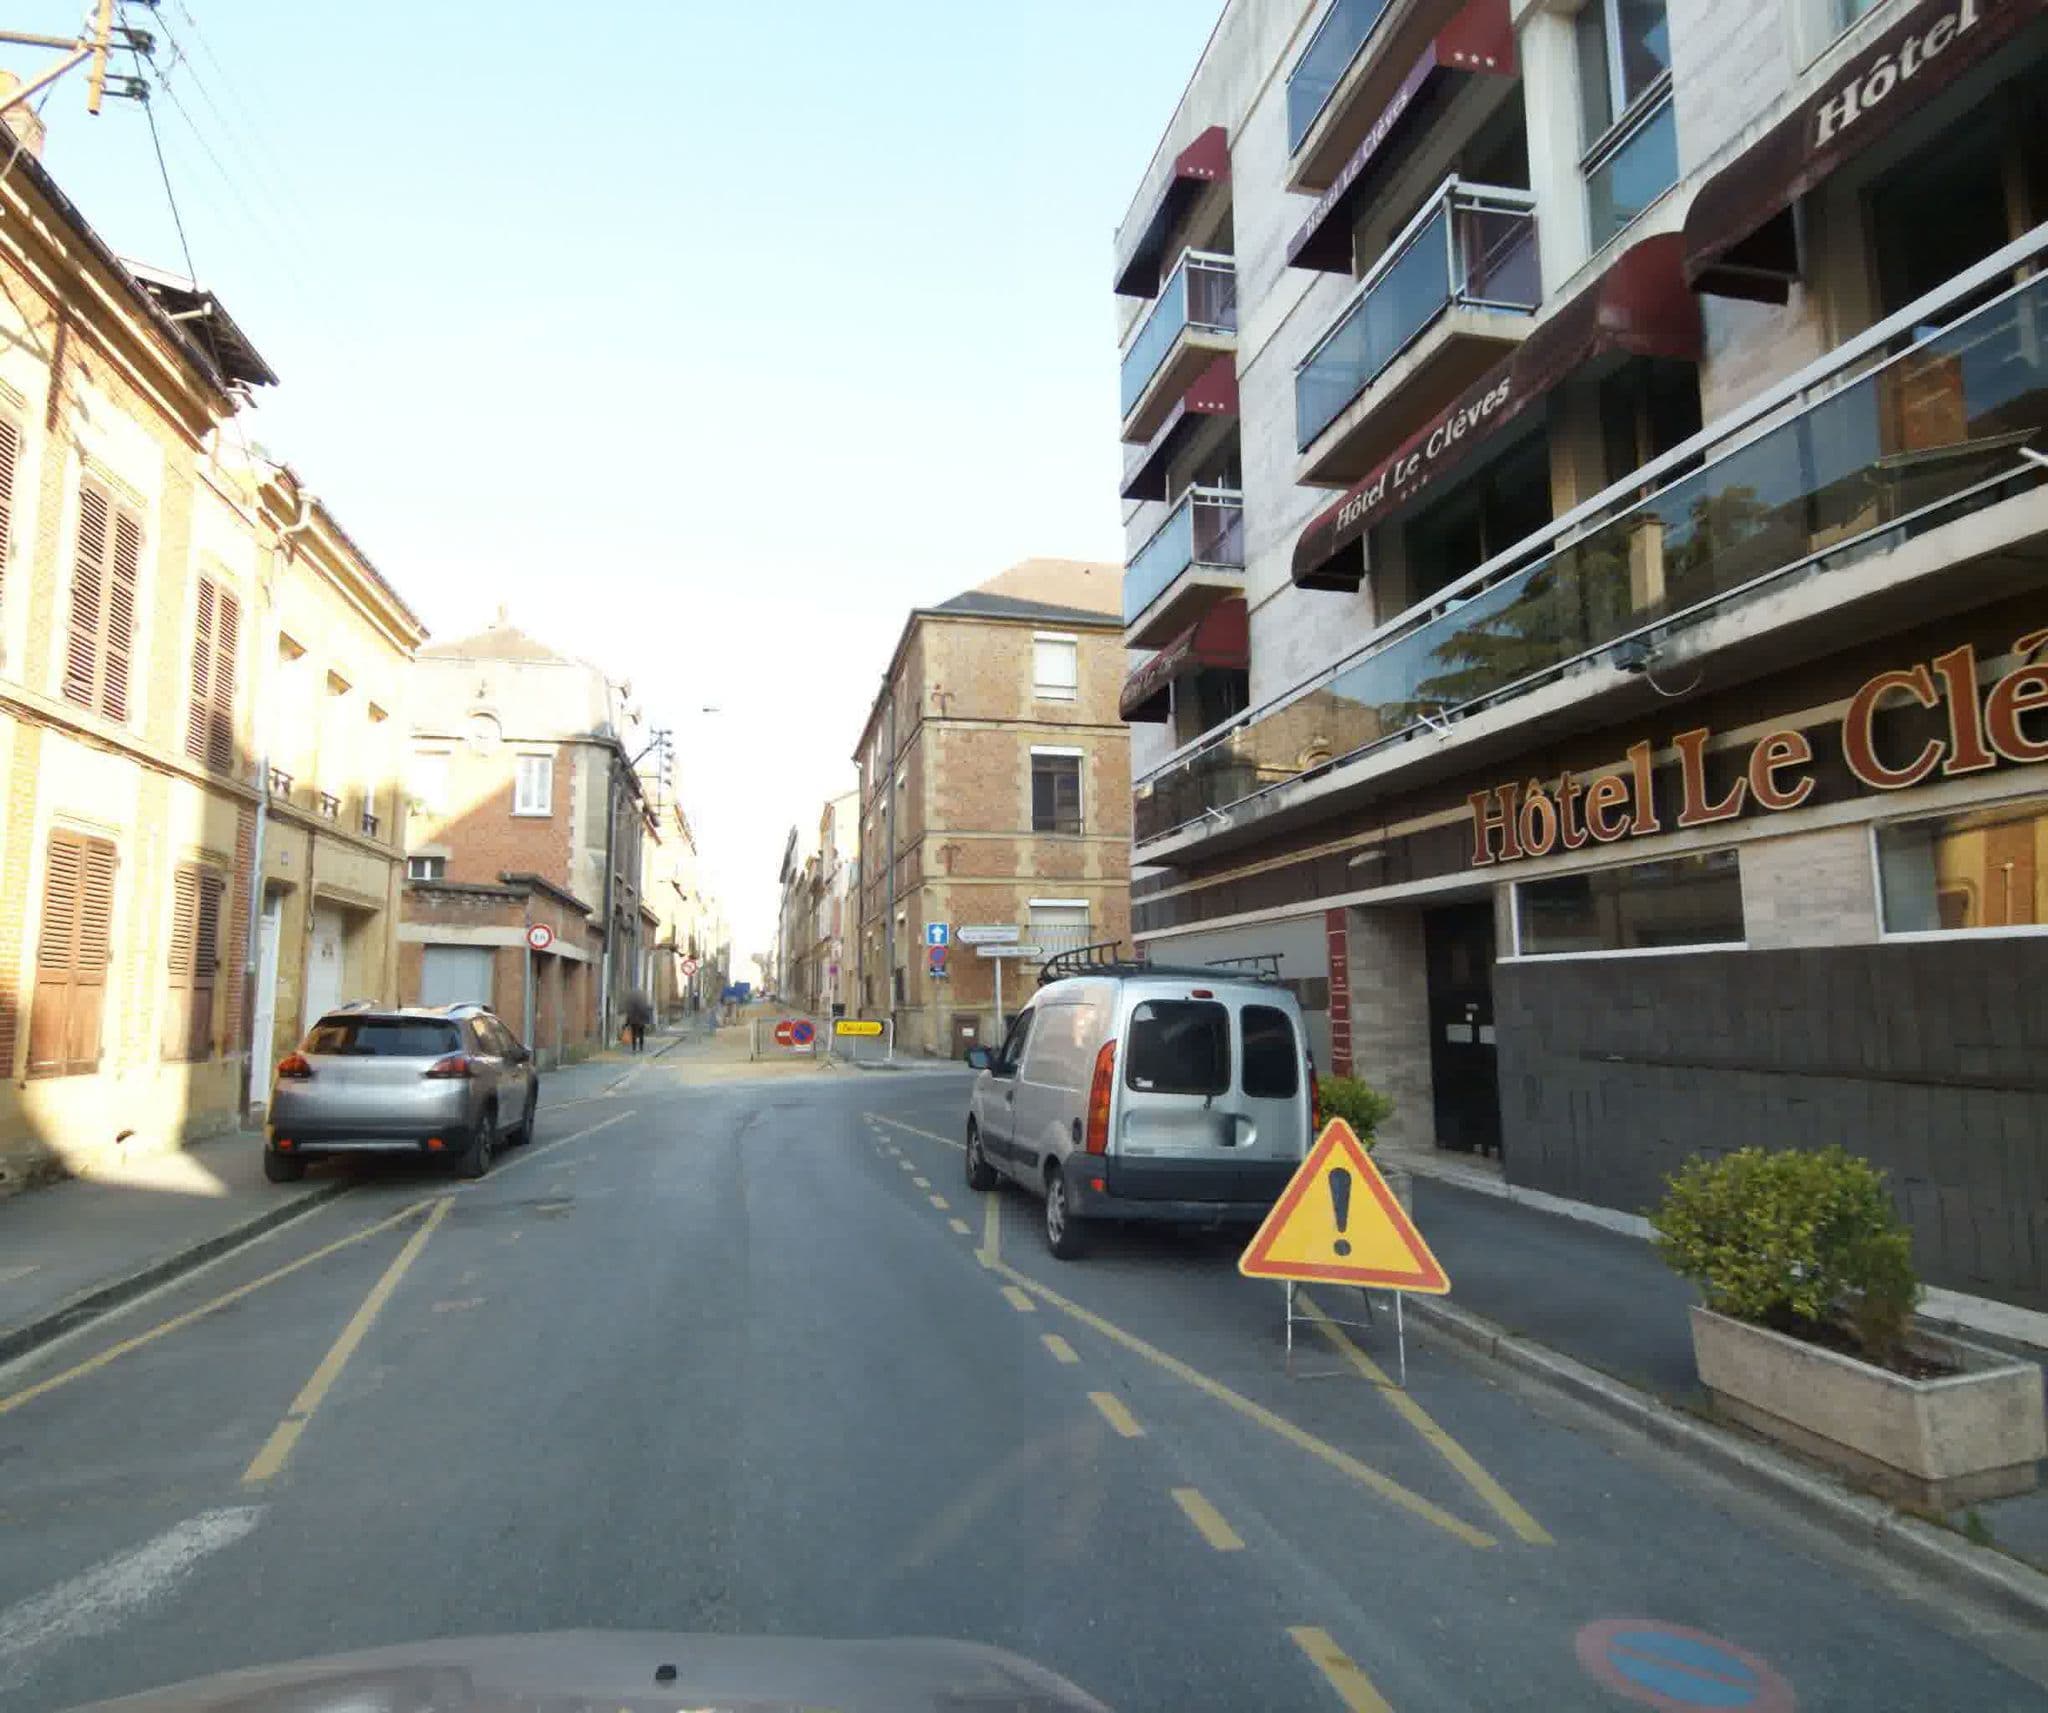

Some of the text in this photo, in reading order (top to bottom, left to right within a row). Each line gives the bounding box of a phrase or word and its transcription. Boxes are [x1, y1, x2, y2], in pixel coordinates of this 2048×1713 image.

[1336, 472, 1387, 532] Hôtel
[1392, 451, 1421, 489] Le
[1467, 737, 1661, 868] Hôtel
[1672, 727, 1816, 829] Le
